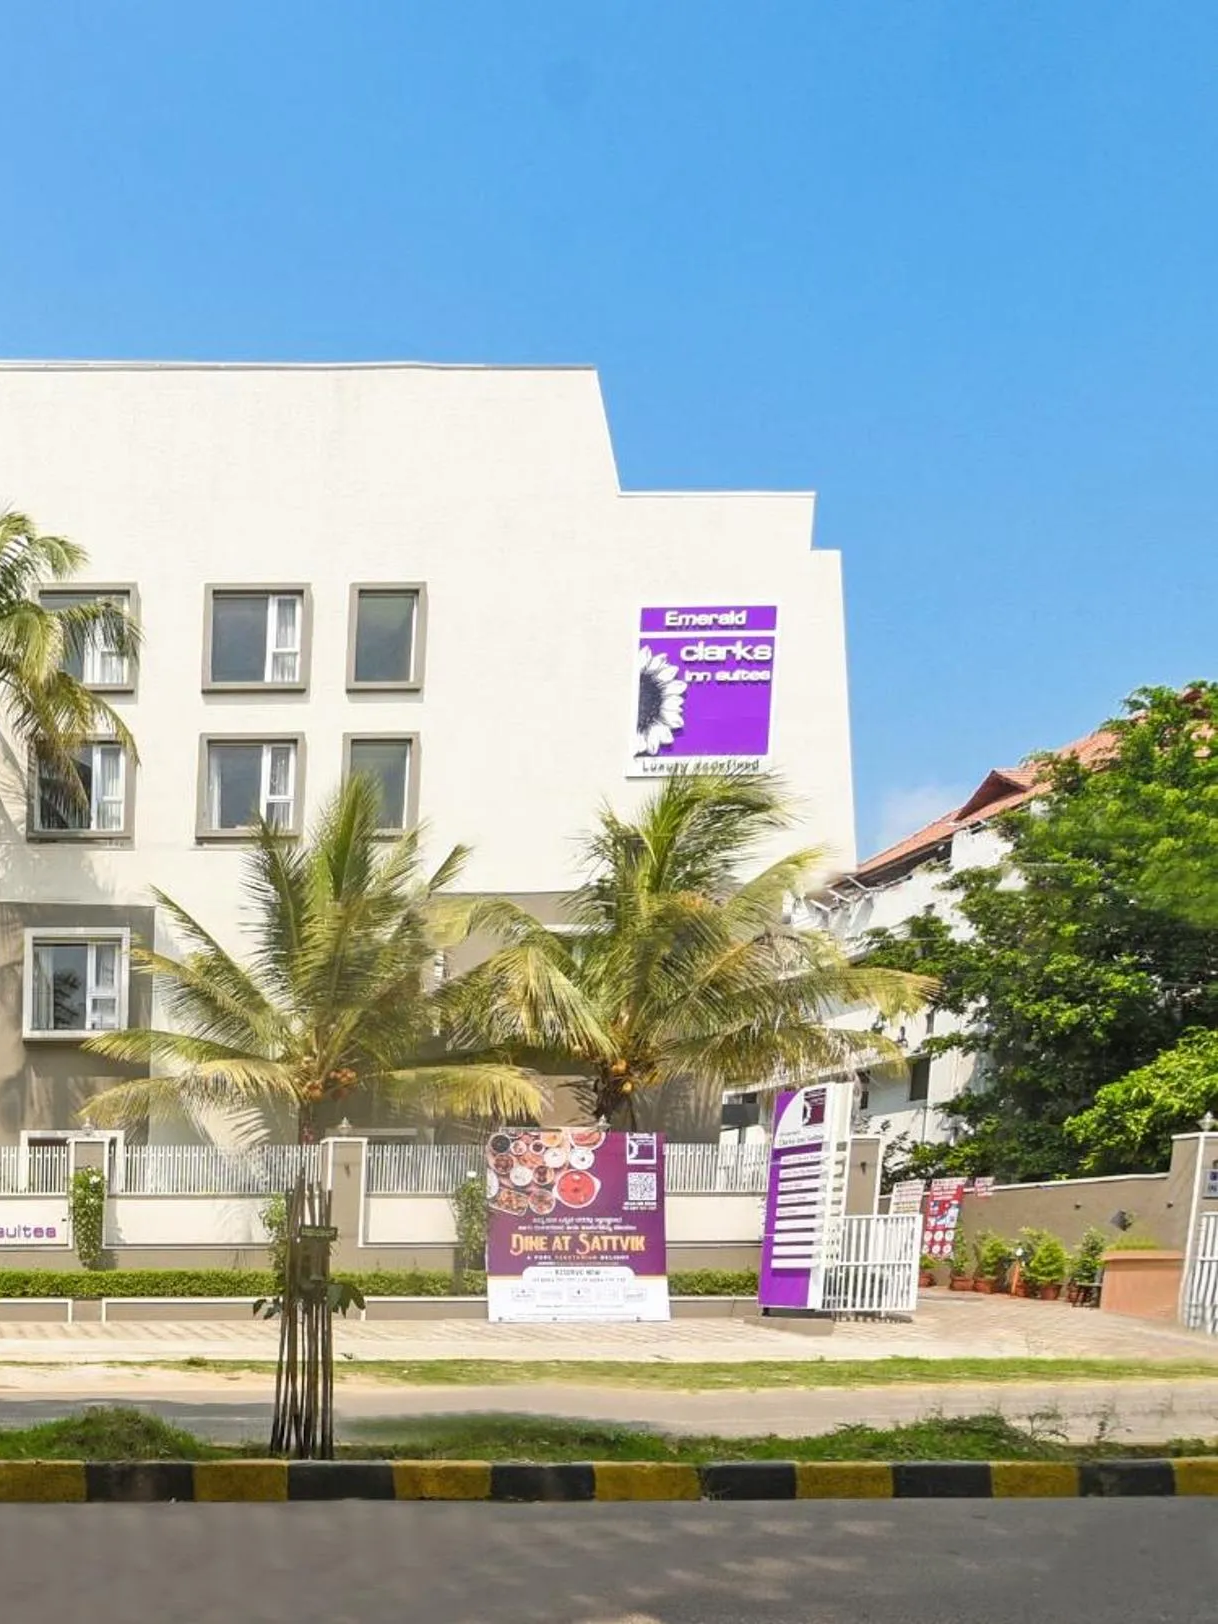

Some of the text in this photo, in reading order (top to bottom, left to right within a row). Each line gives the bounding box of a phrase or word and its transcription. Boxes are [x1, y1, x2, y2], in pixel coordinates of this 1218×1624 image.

[665, 610, 747, 626] Emerald
[680, 640, 772, 662] clarks
[684, 669, 771, 682] inn suites
[510, 1233, 645, 1255] DINE AT SATTVIK
